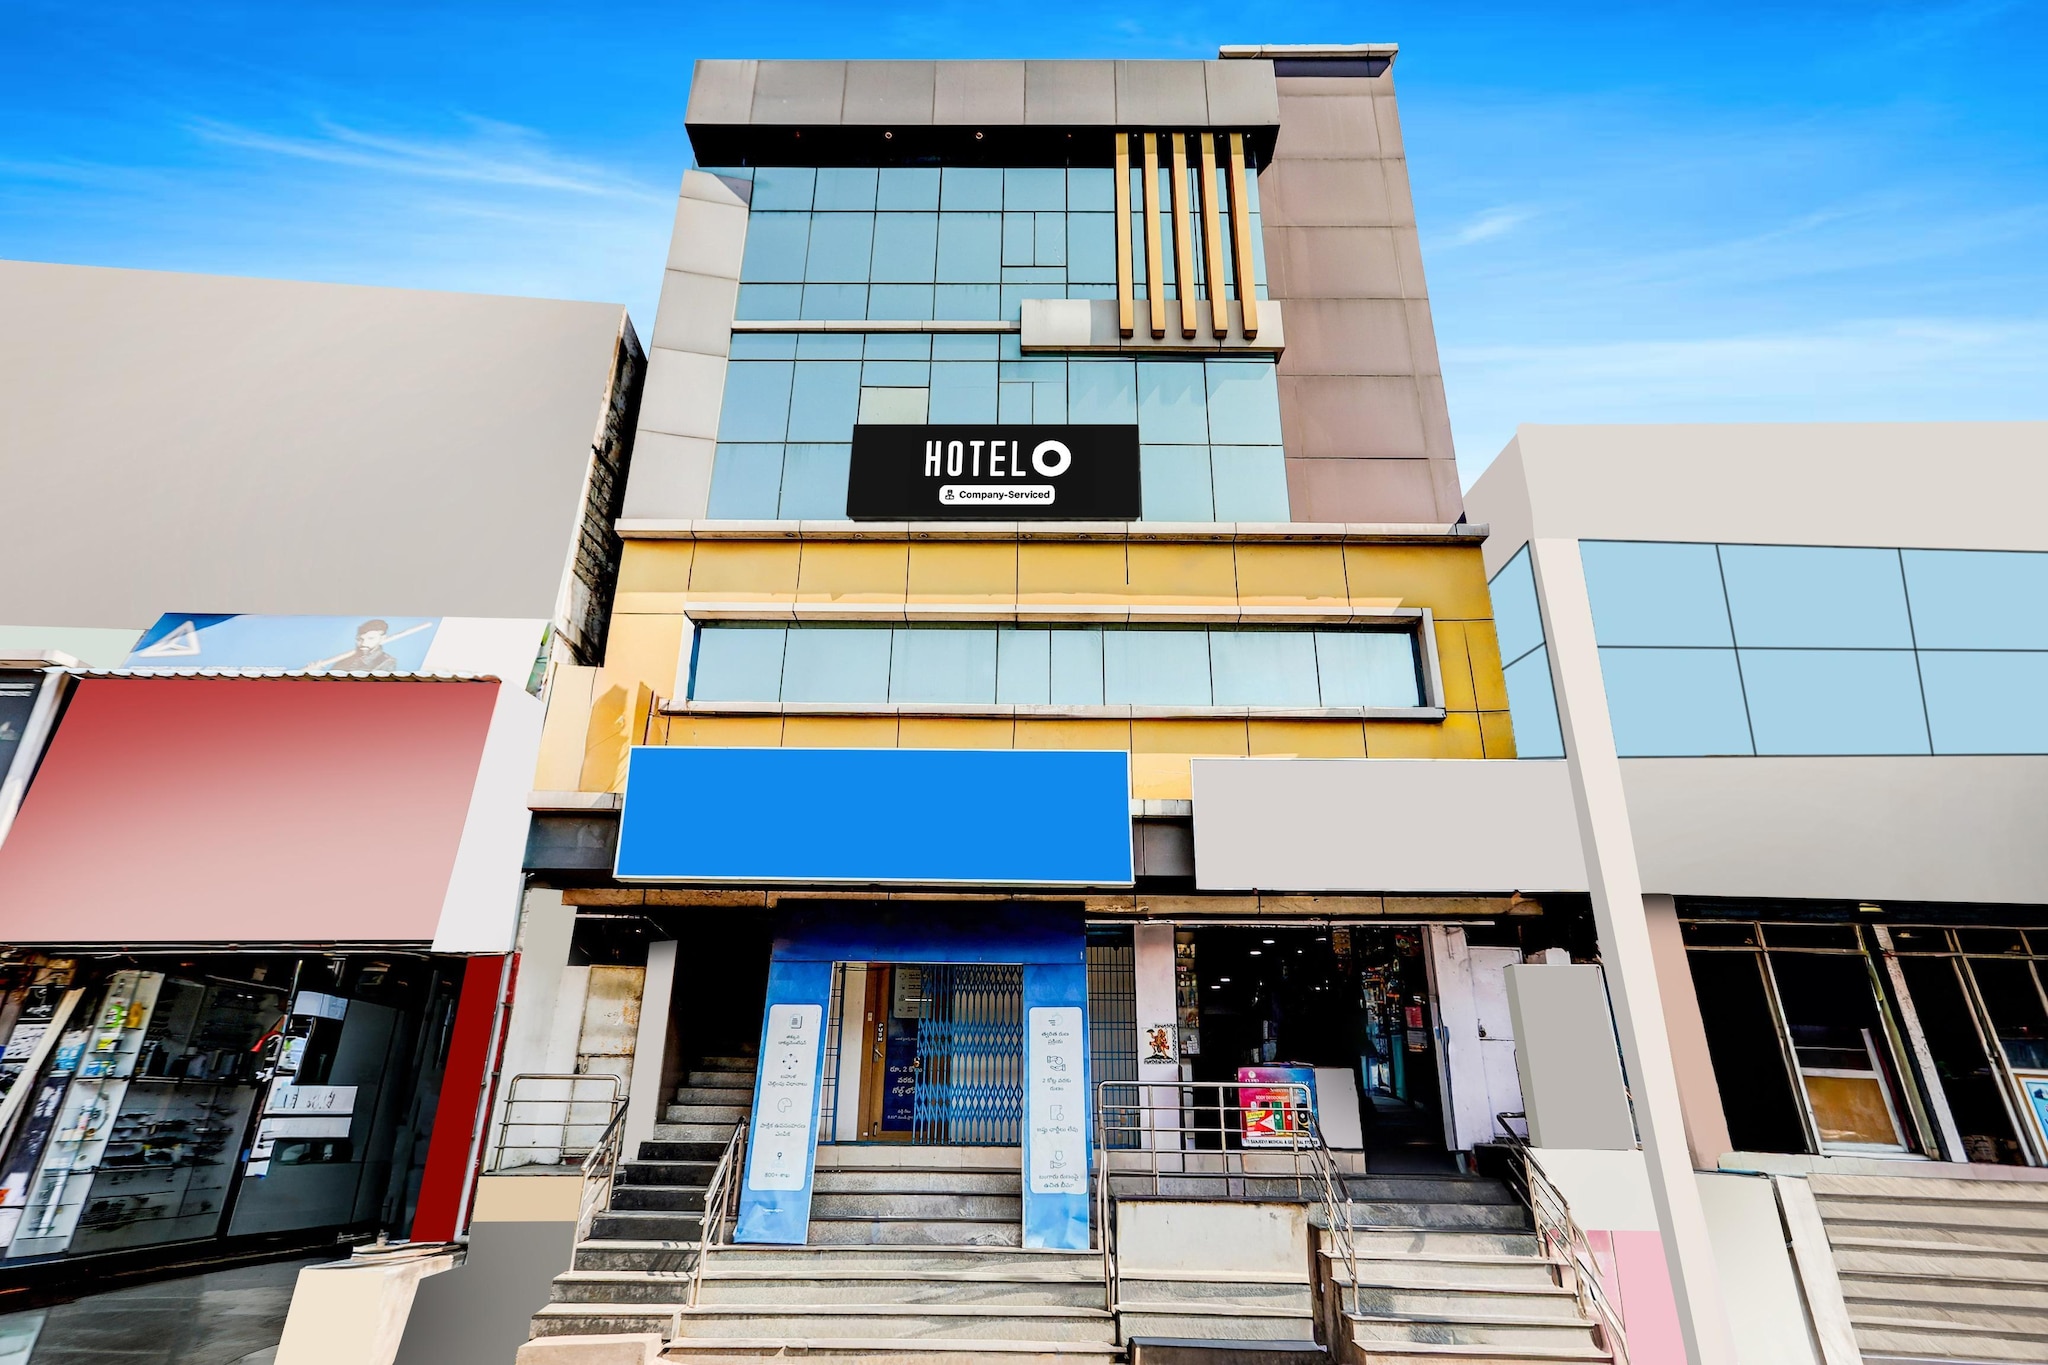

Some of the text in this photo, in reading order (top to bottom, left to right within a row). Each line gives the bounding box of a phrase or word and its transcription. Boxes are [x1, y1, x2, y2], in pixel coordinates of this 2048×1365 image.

[924, 440, 1072, 477] HOTEL O
[959, 490, 1050, 500] Company-Serviced
